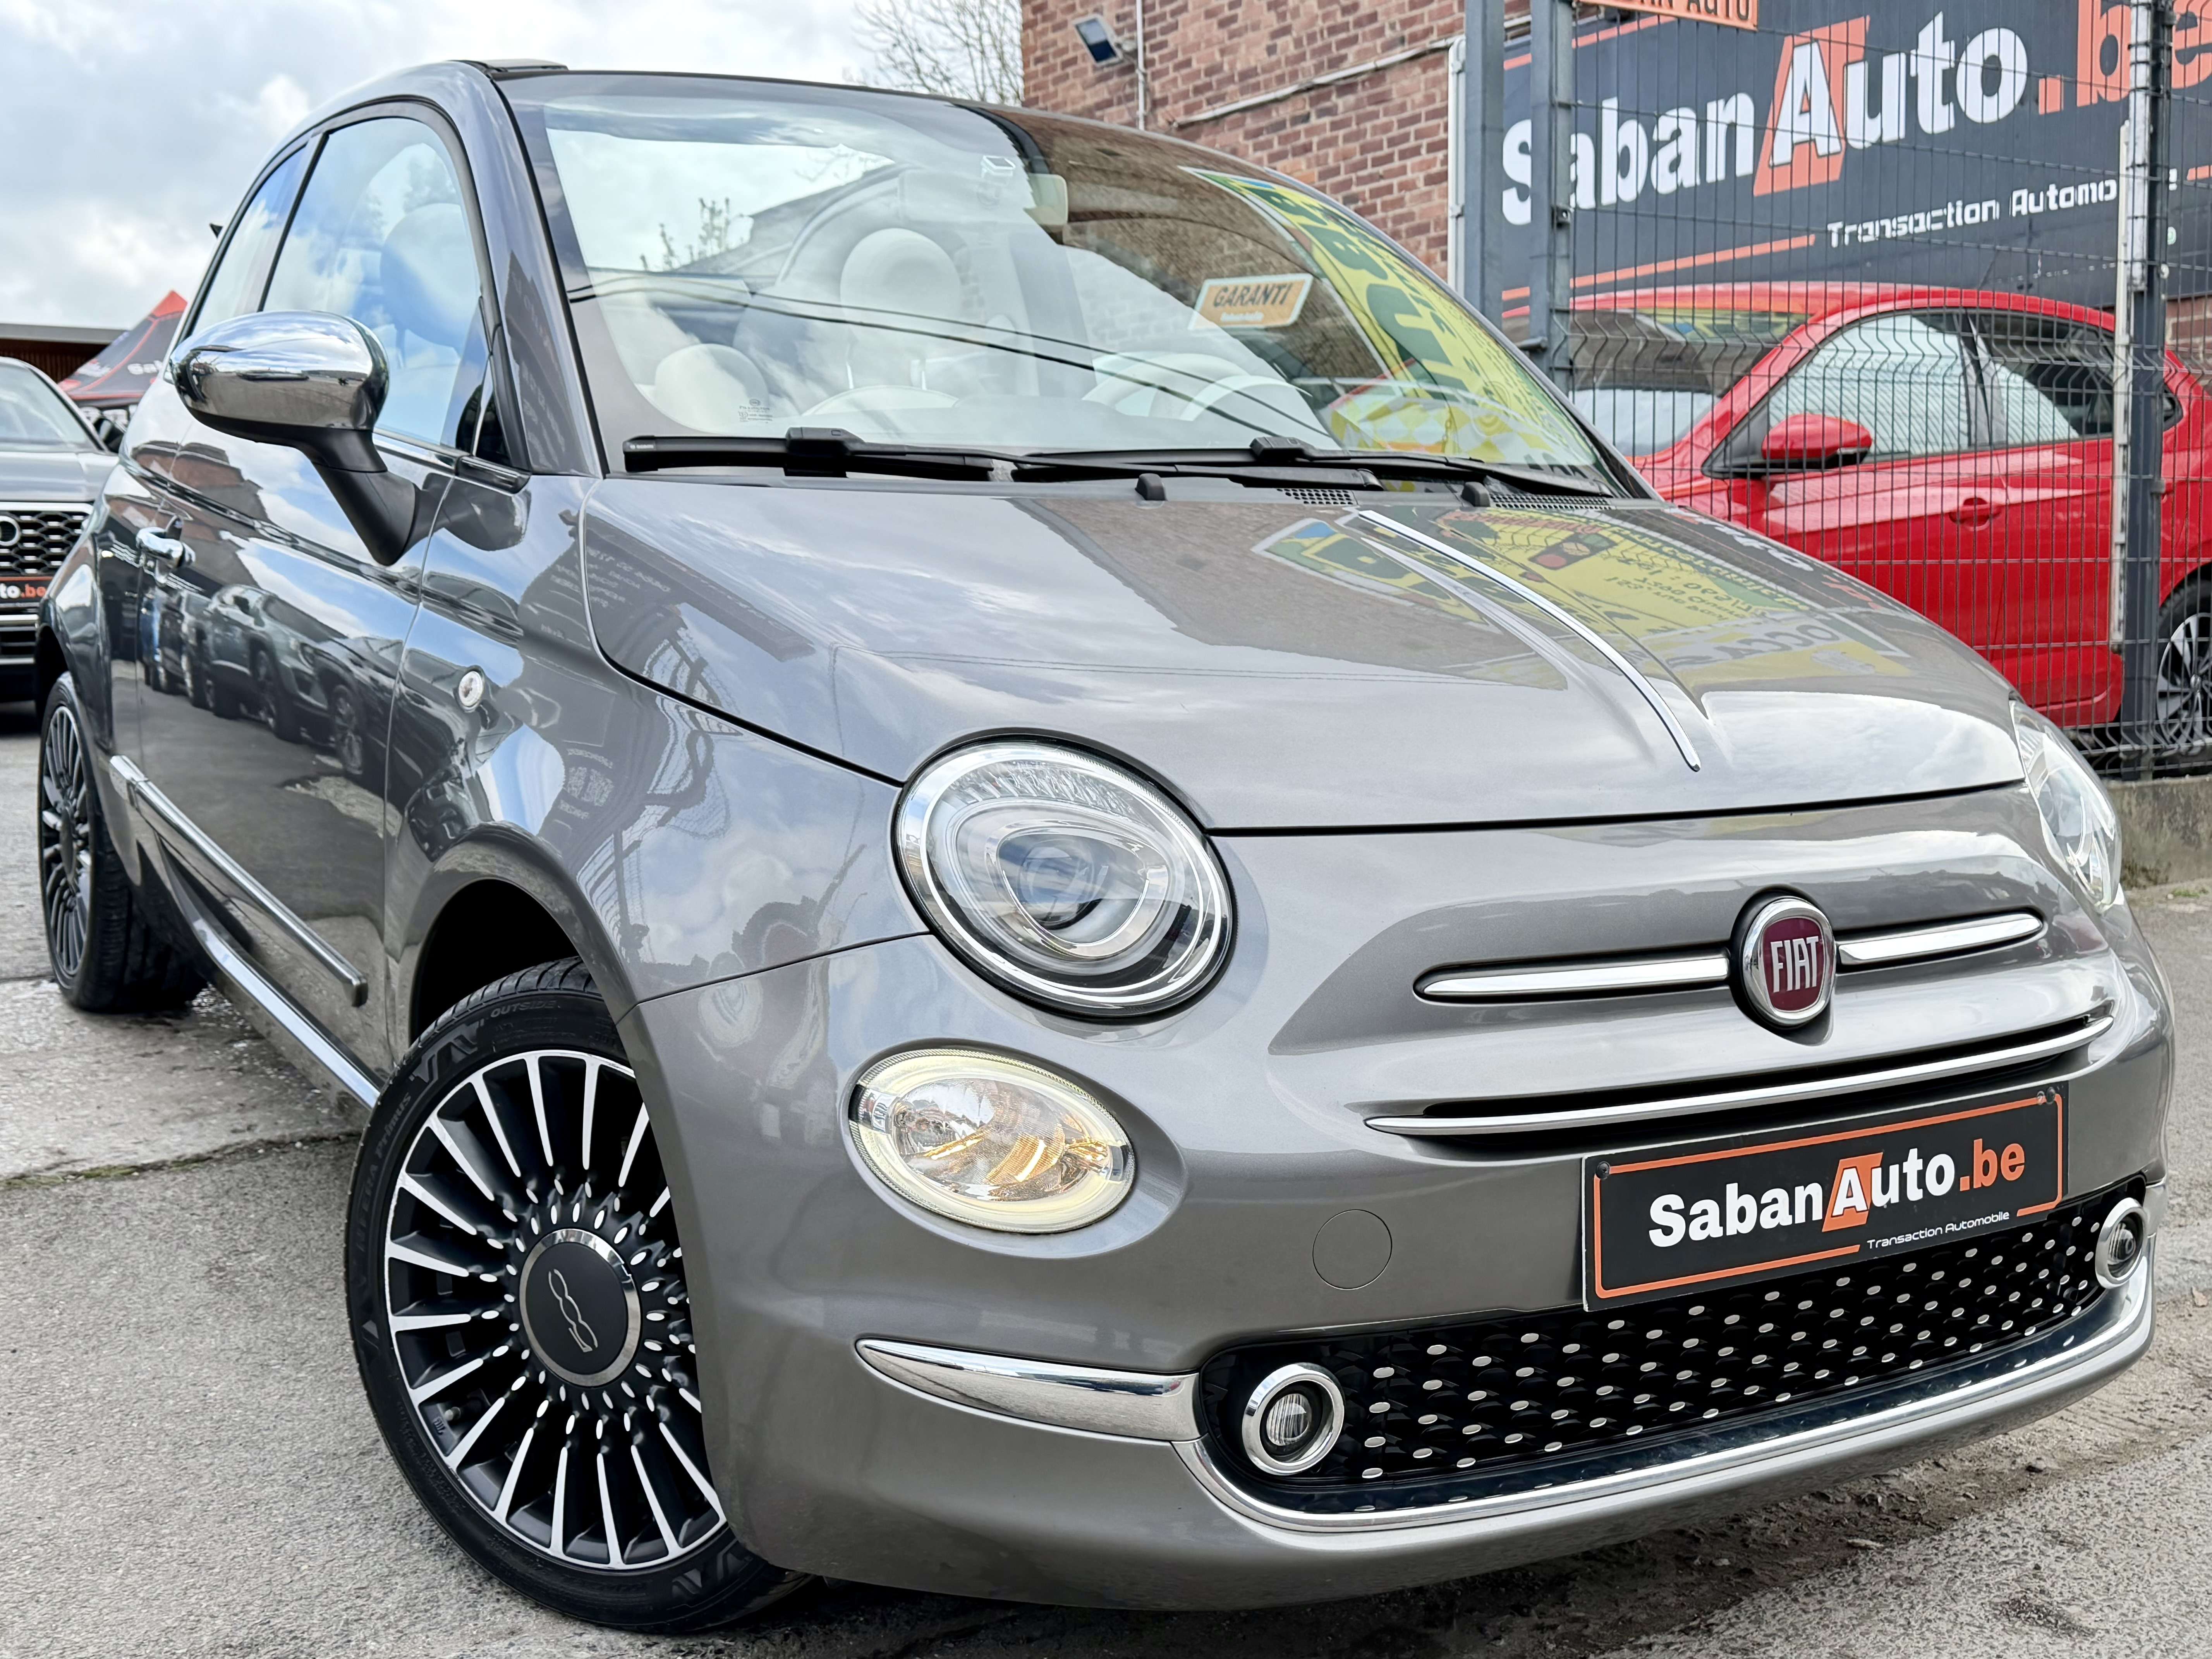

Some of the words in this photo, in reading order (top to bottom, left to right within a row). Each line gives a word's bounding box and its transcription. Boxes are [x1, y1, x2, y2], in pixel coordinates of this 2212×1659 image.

[1827, 199, 1999, 247] Transaction
[1213, 282, 1293, 308] GARANTI
[1769, 934, 1821, 994] FIAT
[491, 1000, 557, 1018] OUTSIDE
[375, 1091, 411, 1159] Primus
[1648, 1138, 2025, 1248] SabanAuto.be
[1867, 1224, 1943, 1250] Transaction
[1945, 1209, 2010, 1234] Automobile
